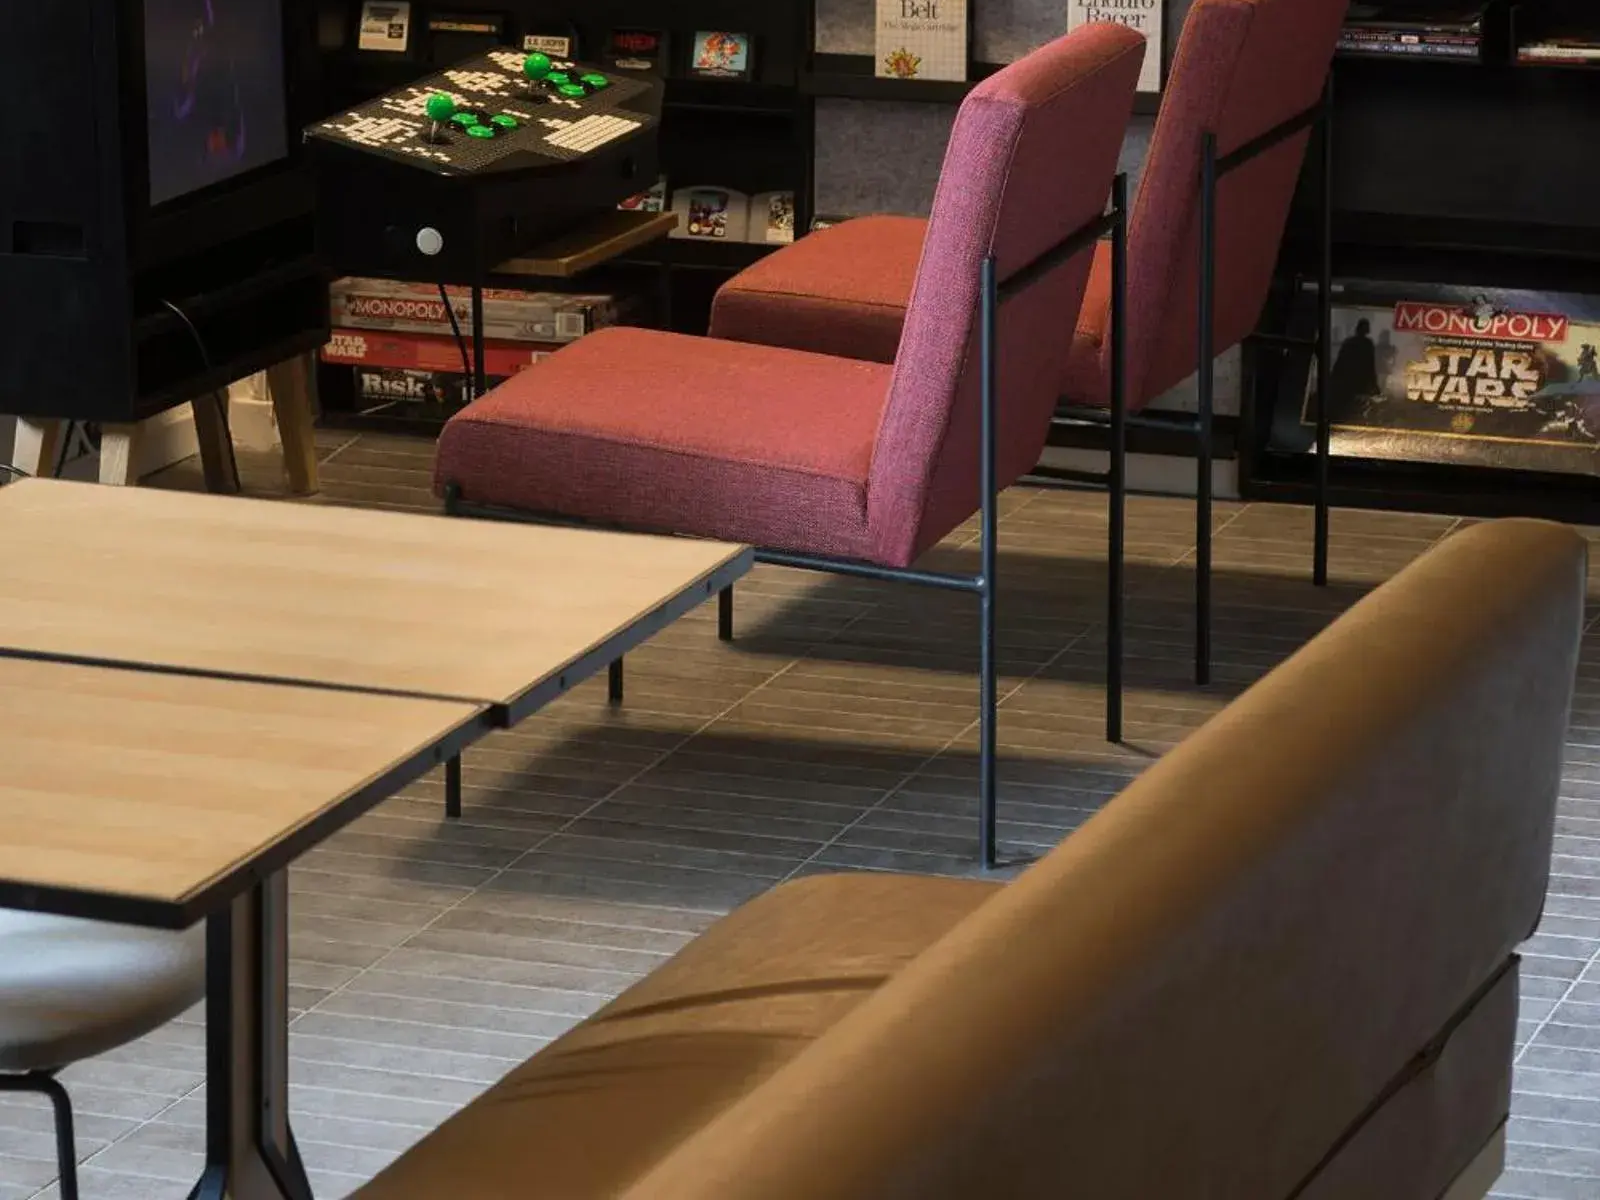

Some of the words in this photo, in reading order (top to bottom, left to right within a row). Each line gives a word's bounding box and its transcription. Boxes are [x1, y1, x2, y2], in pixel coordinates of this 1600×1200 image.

[900, 0, 939, 20] Belt
[1085, 7, 1148, 28] Racer
[356, 299, 446, 320] MONOPOLY
[1397, 306, 1565, 340] MONOPOLY
[1406, 346, 1540, 380] STAR
[361, 373, 425, 397] Risk
[1406, 374, 1540, 408] WARS
